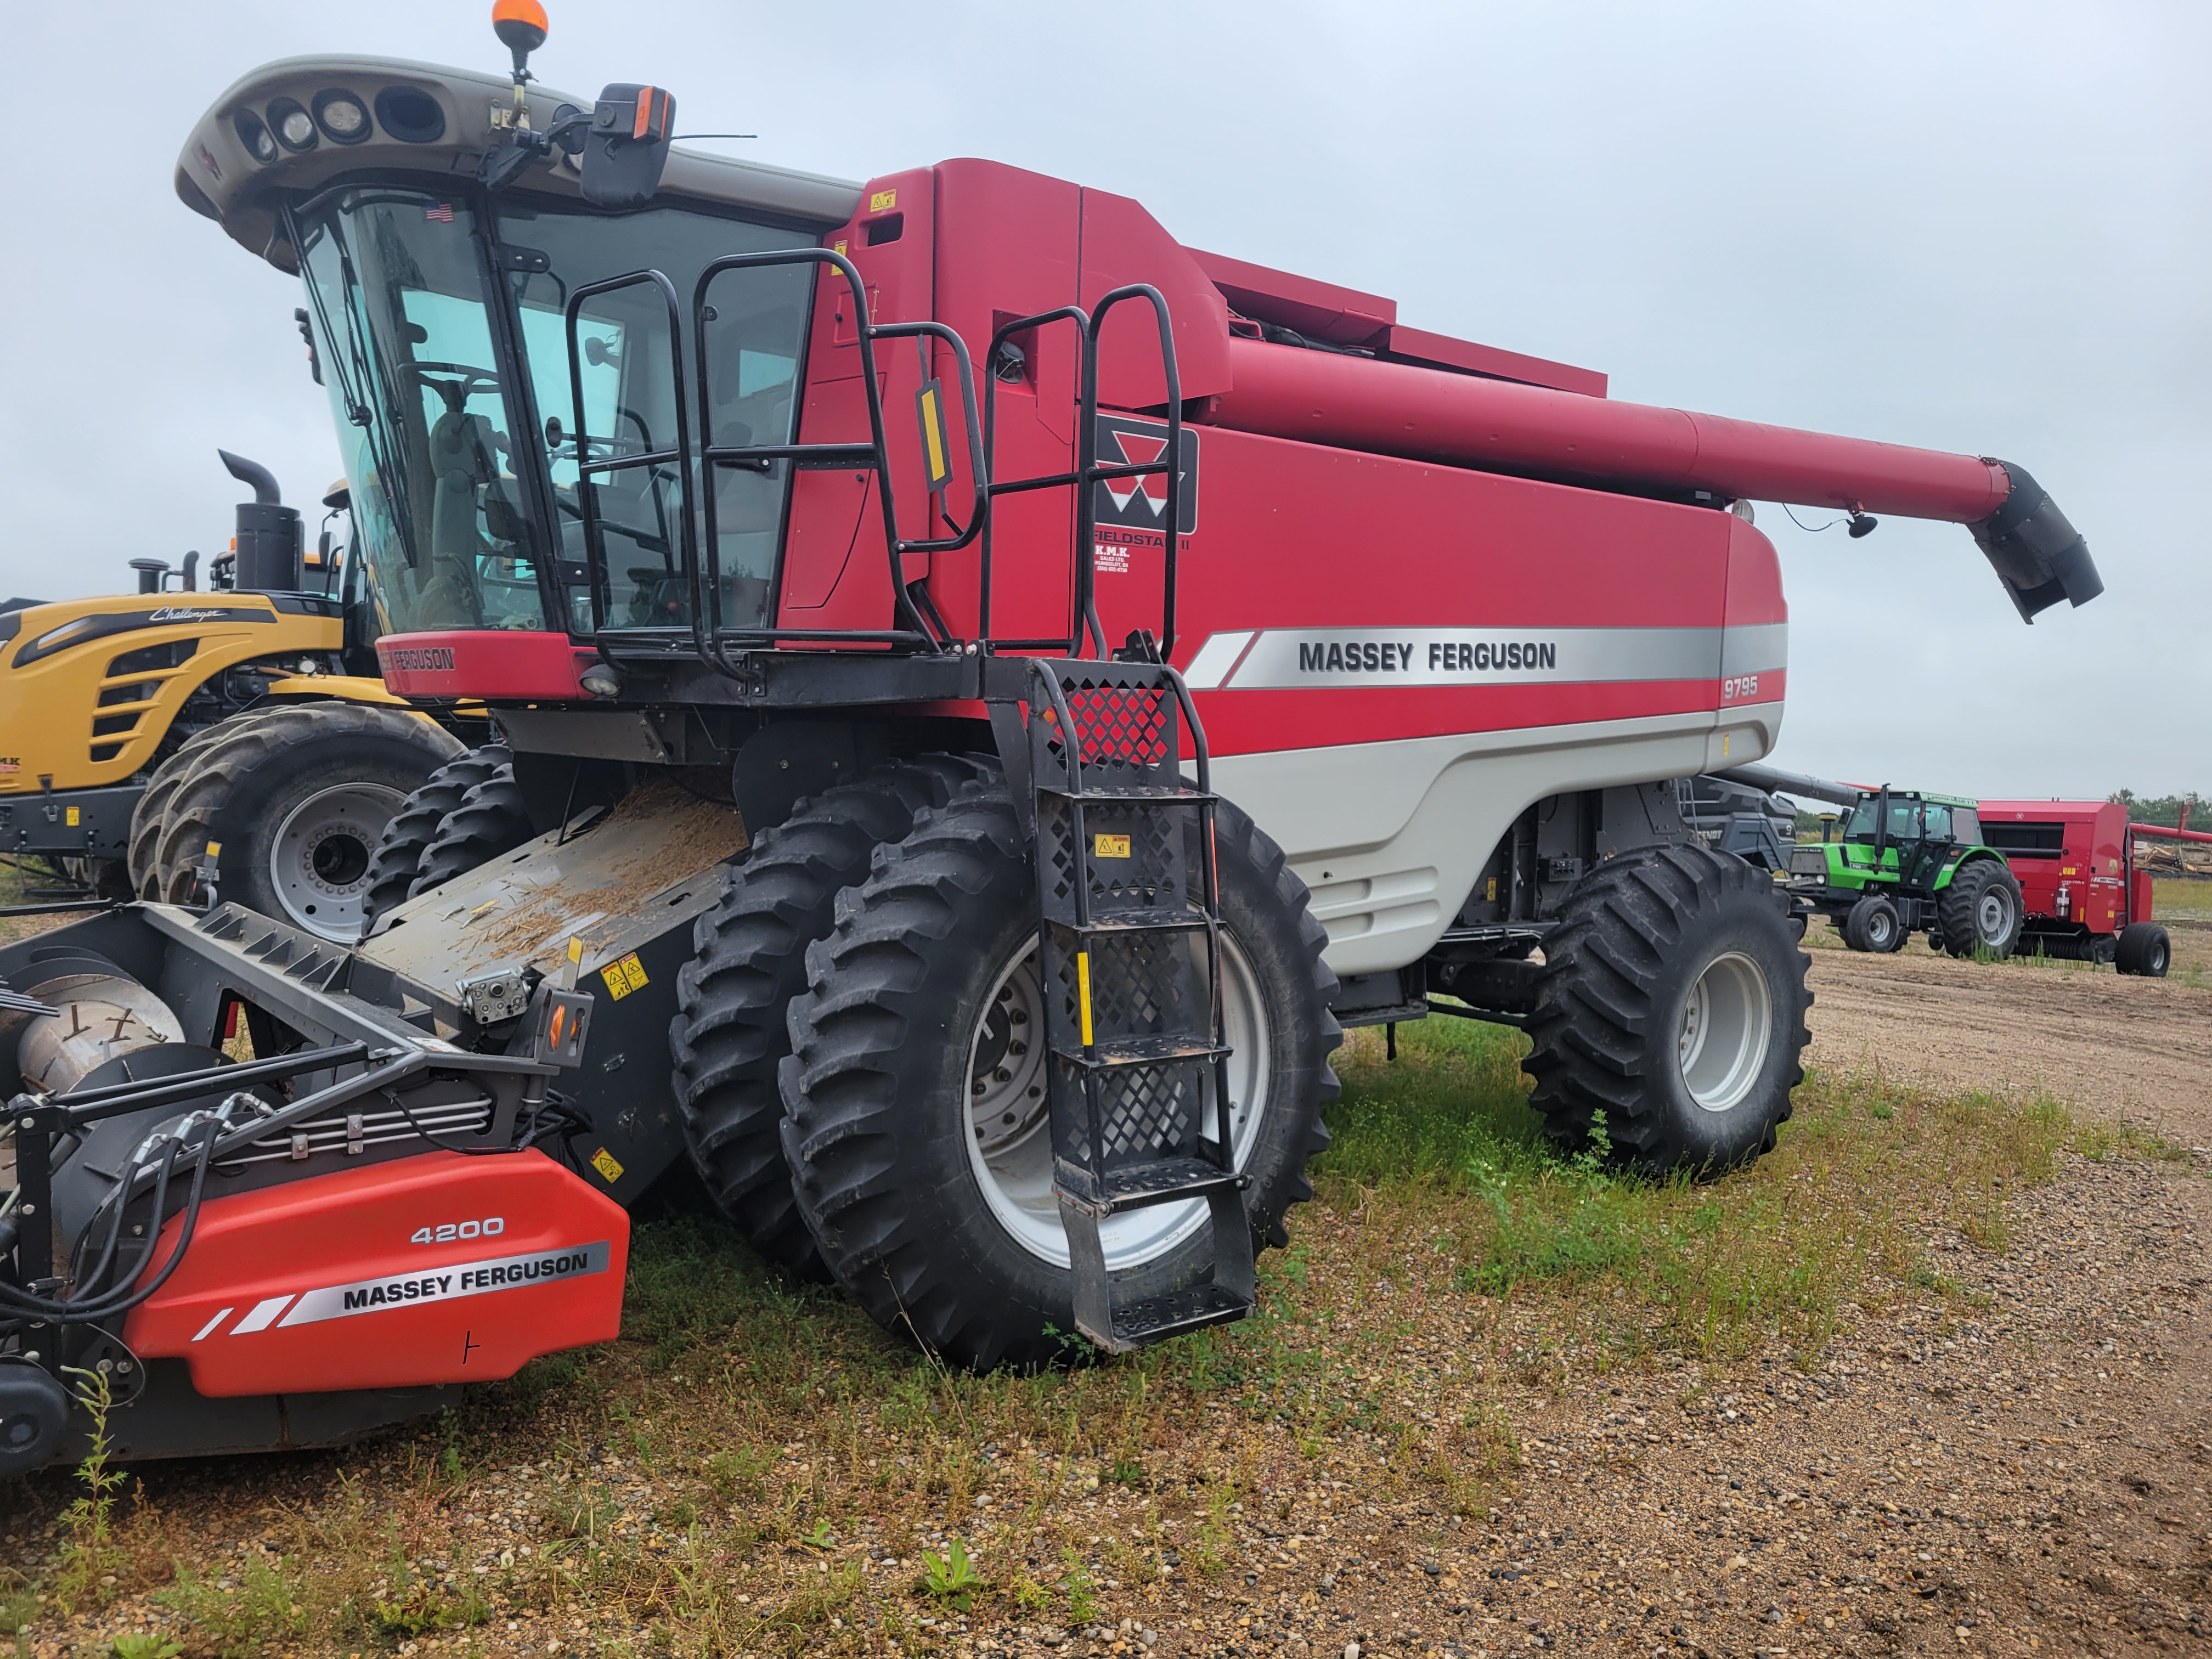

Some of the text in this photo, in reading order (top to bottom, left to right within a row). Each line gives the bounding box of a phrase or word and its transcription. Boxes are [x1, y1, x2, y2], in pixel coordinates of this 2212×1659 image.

[1095, 531, 1164, 548] IELDSTA
[1095, 545, 1130, 557] K.M.K.
[149, 605, 229, 623] Challenger
[394, 648, 455, 670] FERGUSON
[1299, 642, 1557, 672] MASSEY FERGUSON
[1724, 675, 1758, 699] 9795
[1786, 824, 1792, 836] 9
[410, 1217, 505, 1244] 4200
[343, 1252, 588, 1310] MASSEY FERGUSON
